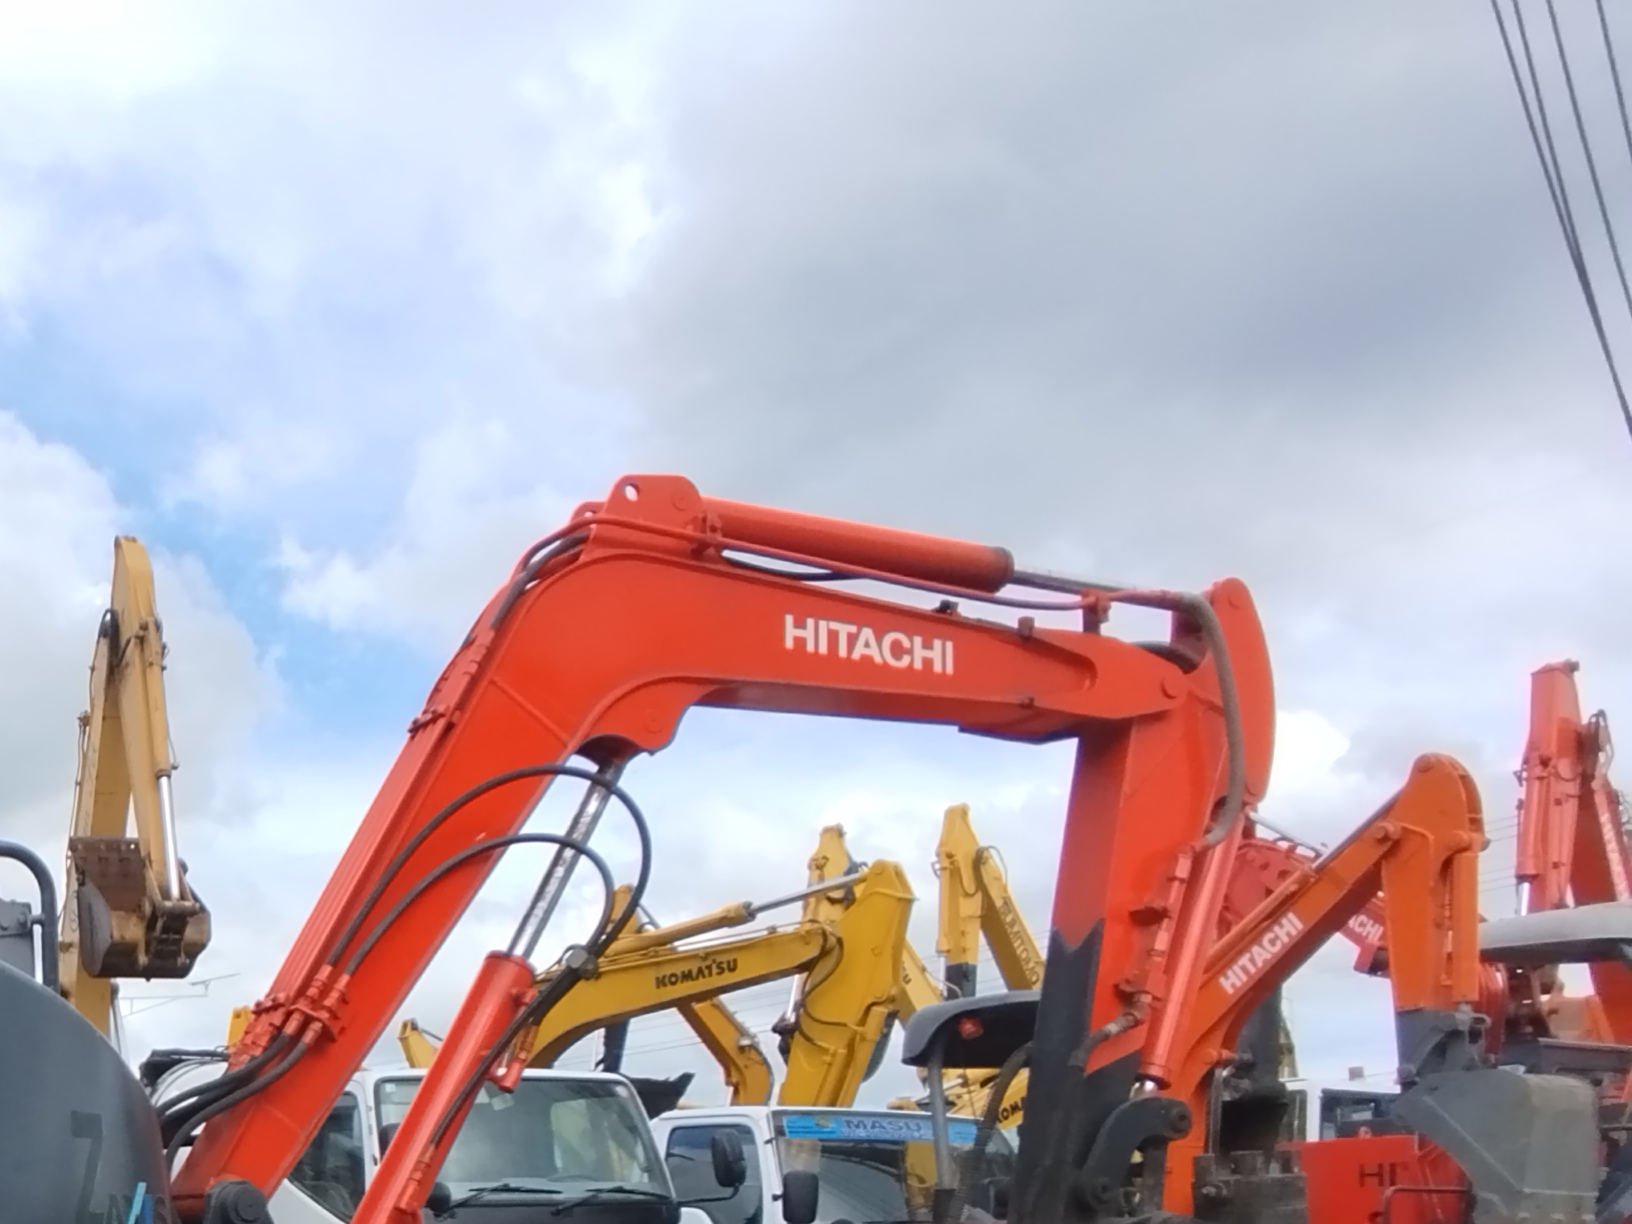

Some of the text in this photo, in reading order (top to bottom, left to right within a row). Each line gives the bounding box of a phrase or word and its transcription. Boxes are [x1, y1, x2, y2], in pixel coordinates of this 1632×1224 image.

[784, 613, 955, 676] HITACHI
[654, 958, 739, 990] KOMATSU
[1219, 911, 1305, 995] HITACHI
